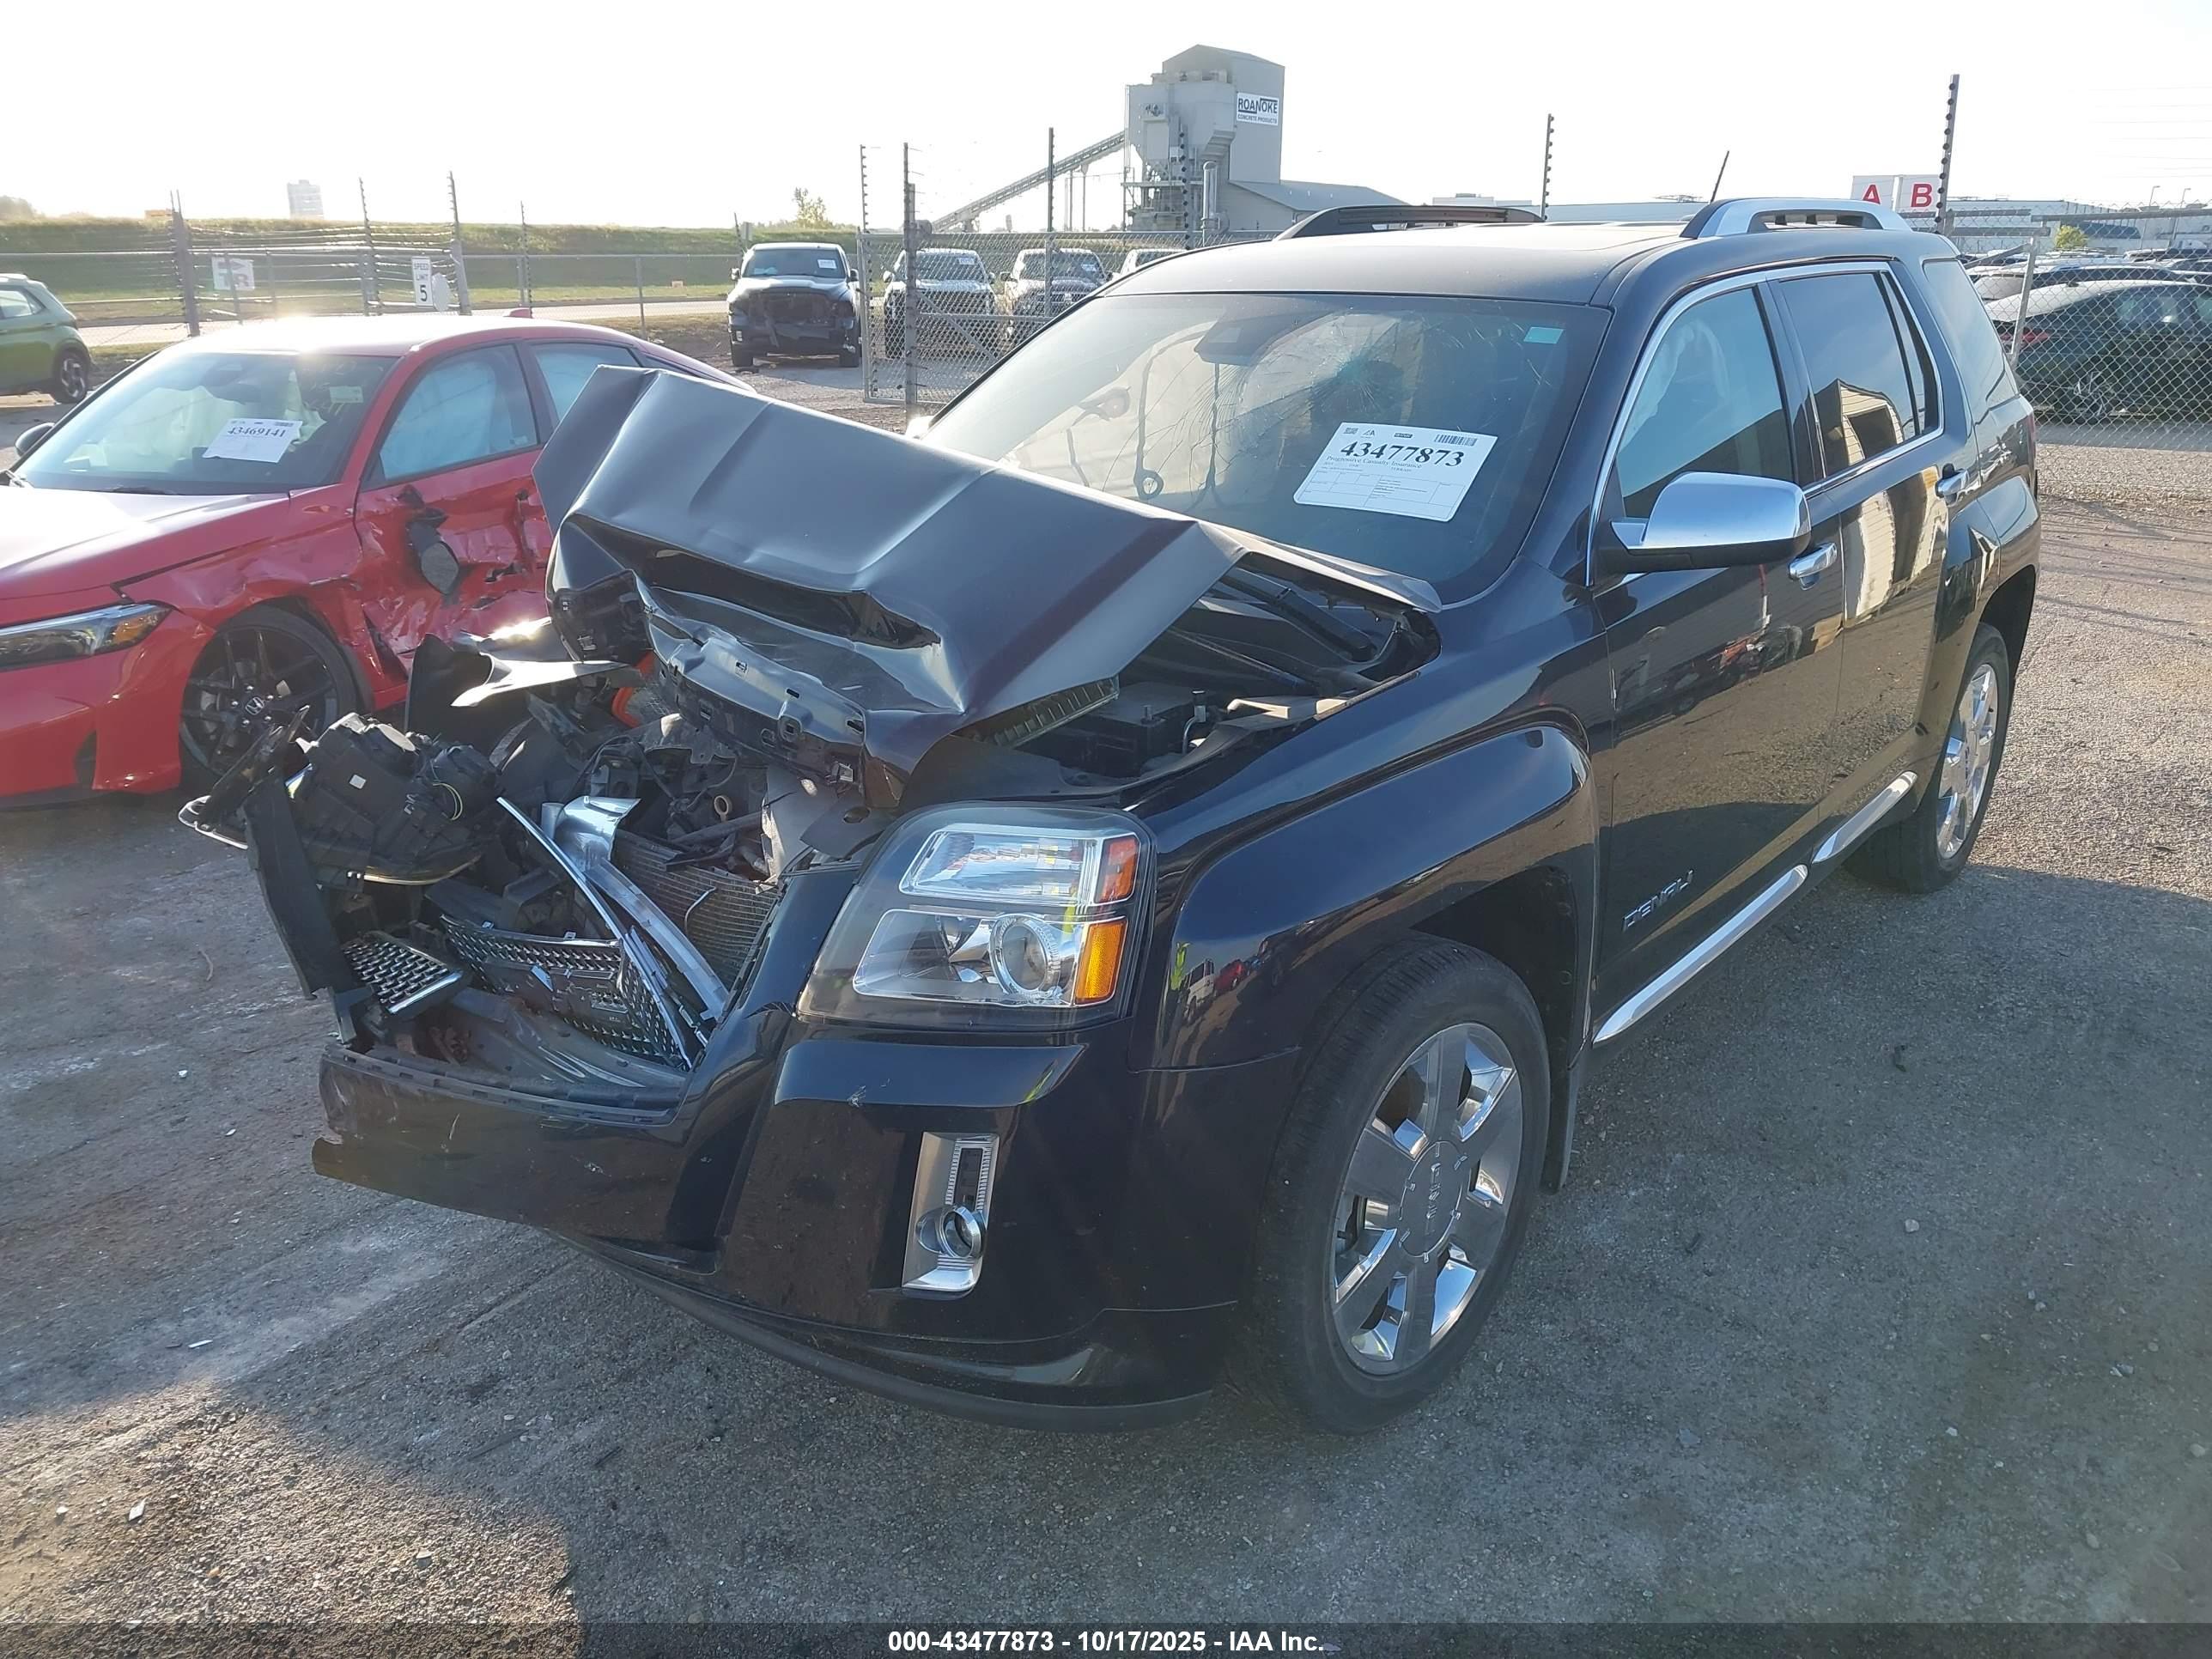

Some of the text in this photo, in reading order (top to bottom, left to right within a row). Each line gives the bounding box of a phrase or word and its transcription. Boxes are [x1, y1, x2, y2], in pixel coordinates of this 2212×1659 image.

[1237, 97, 1279, 114] ROANOKE
[1863, 184, 1881, 205] A
[1911, 183, 1933, 207] B
[419, 284, 428, 301] 5
[228, 426, 286, 437] 43469141
[1340, 441, 1465, 468] 43477873
[1621, 868, 1693, 933] DENALI
